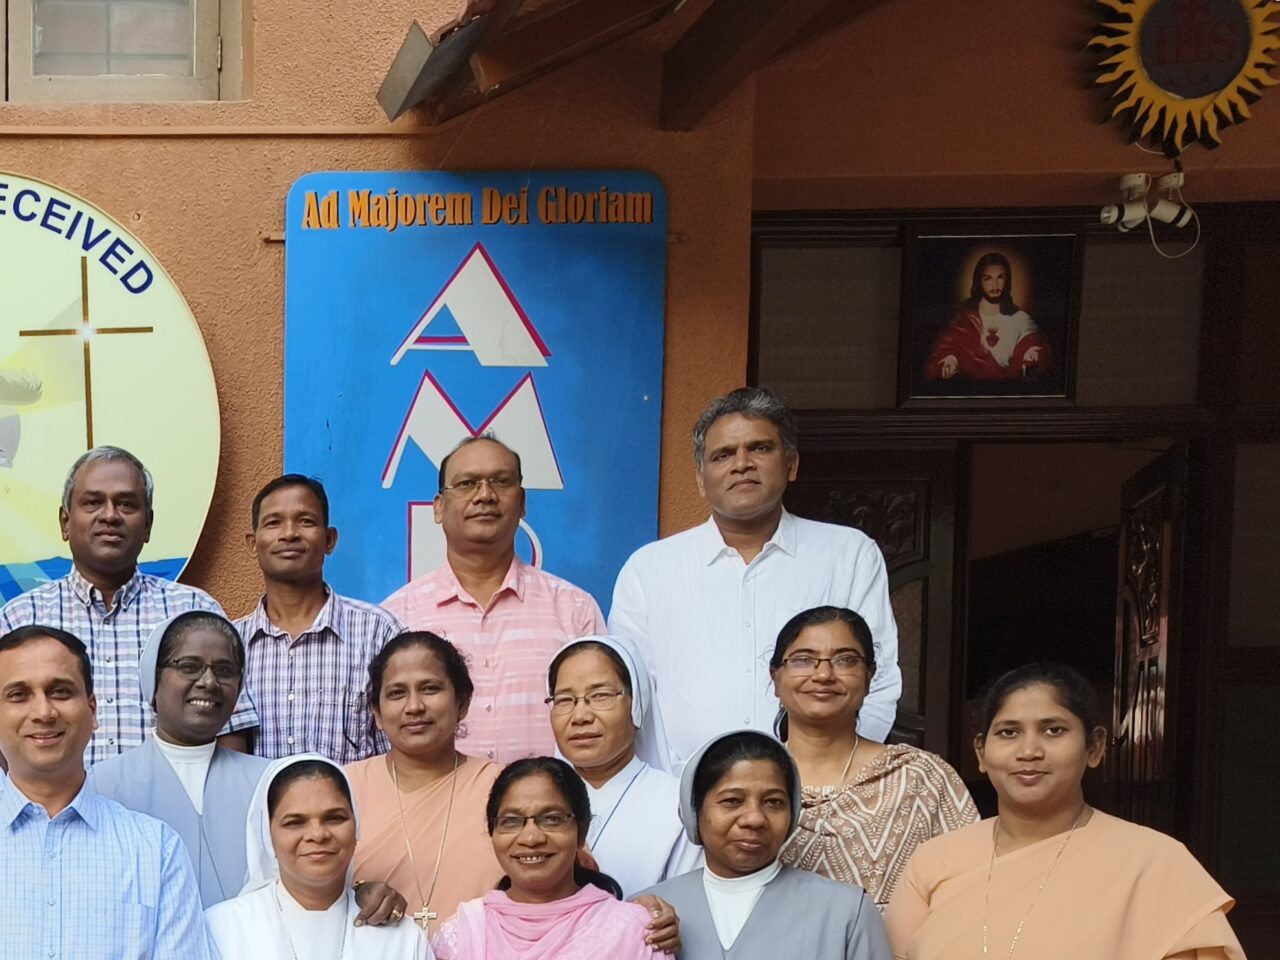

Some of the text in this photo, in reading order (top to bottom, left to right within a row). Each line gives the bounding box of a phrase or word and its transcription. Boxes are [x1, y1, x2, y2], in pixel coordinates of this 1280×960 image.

[301, 186, 654, 232] Ad Majorem Dei Gloriam
